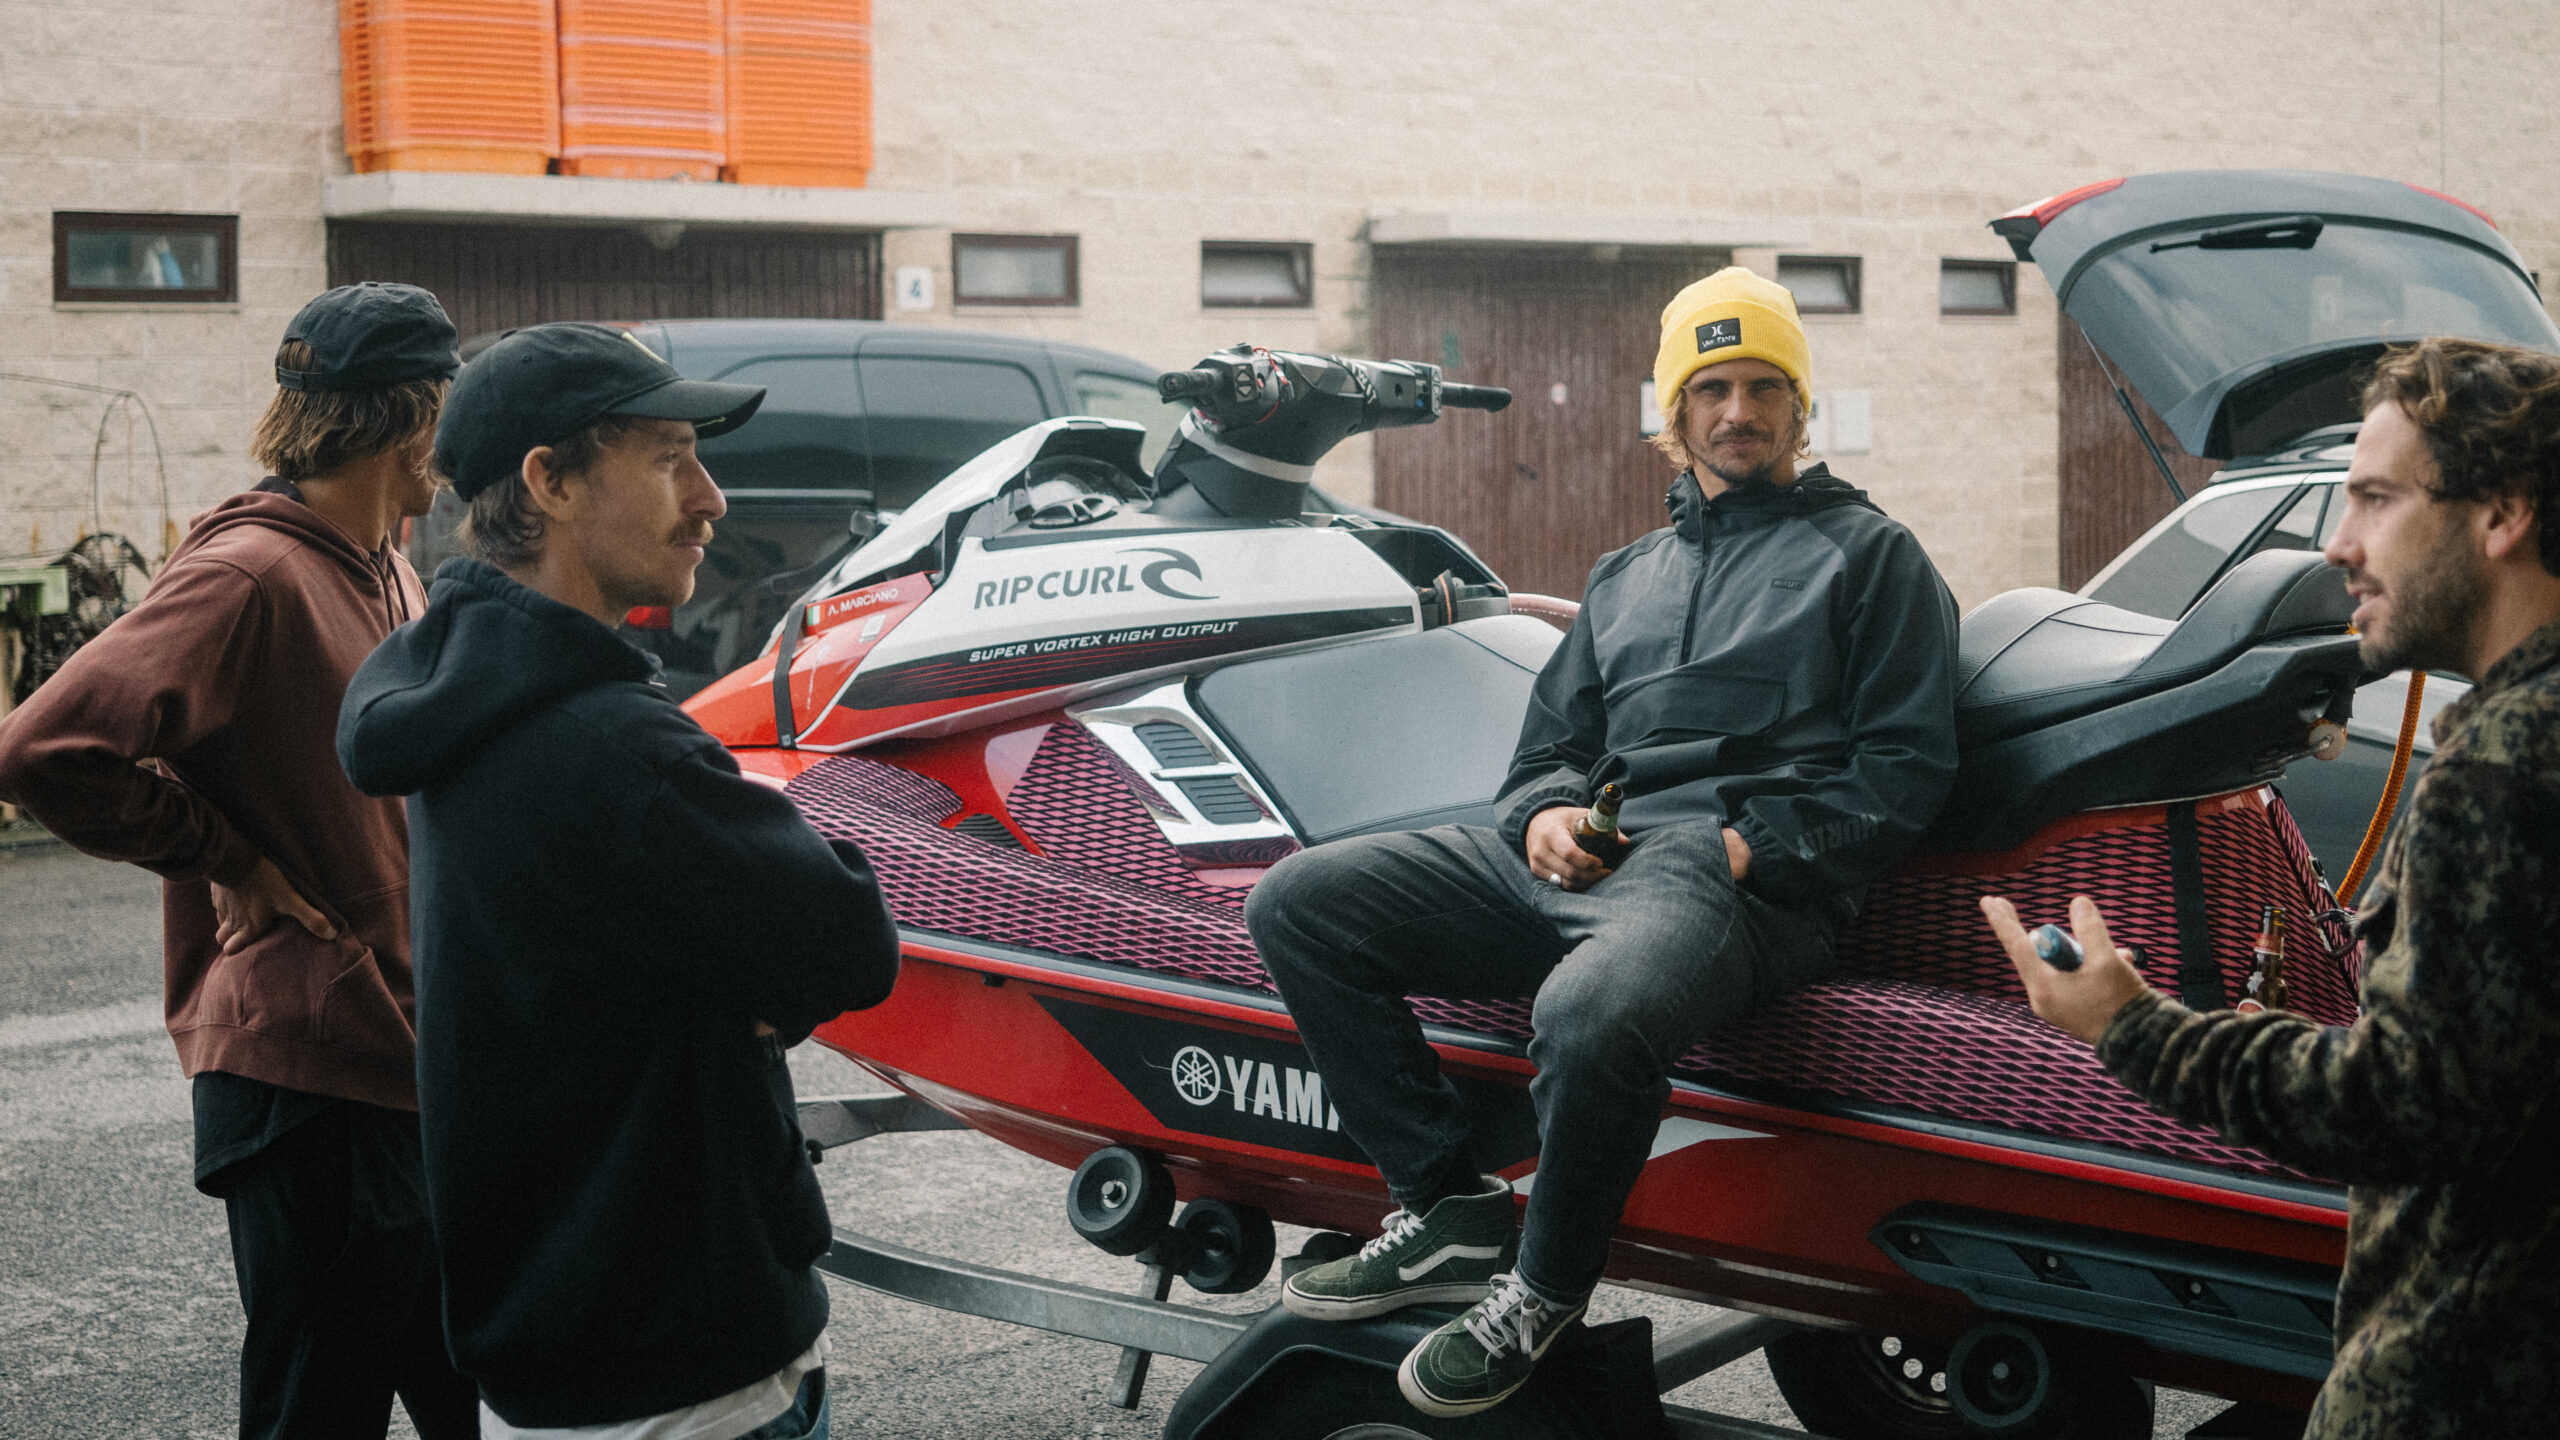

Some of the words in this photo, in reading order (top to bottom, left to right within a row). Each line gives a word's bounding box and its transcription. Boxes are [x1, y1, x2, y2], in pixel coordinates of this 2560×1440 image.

[840, 588, 899, 613] MARCIANO
[973, 575, 1034, 610] RIP
[1036, 564, 1135, 600] CURL
[968, 643, 1028, 663] SUPER
[1033, 634, 1103, 653] VORTEX
[1107, 628, 1156, 644] HIGH
[1161, 621, 1239, 639] OUTPUT
